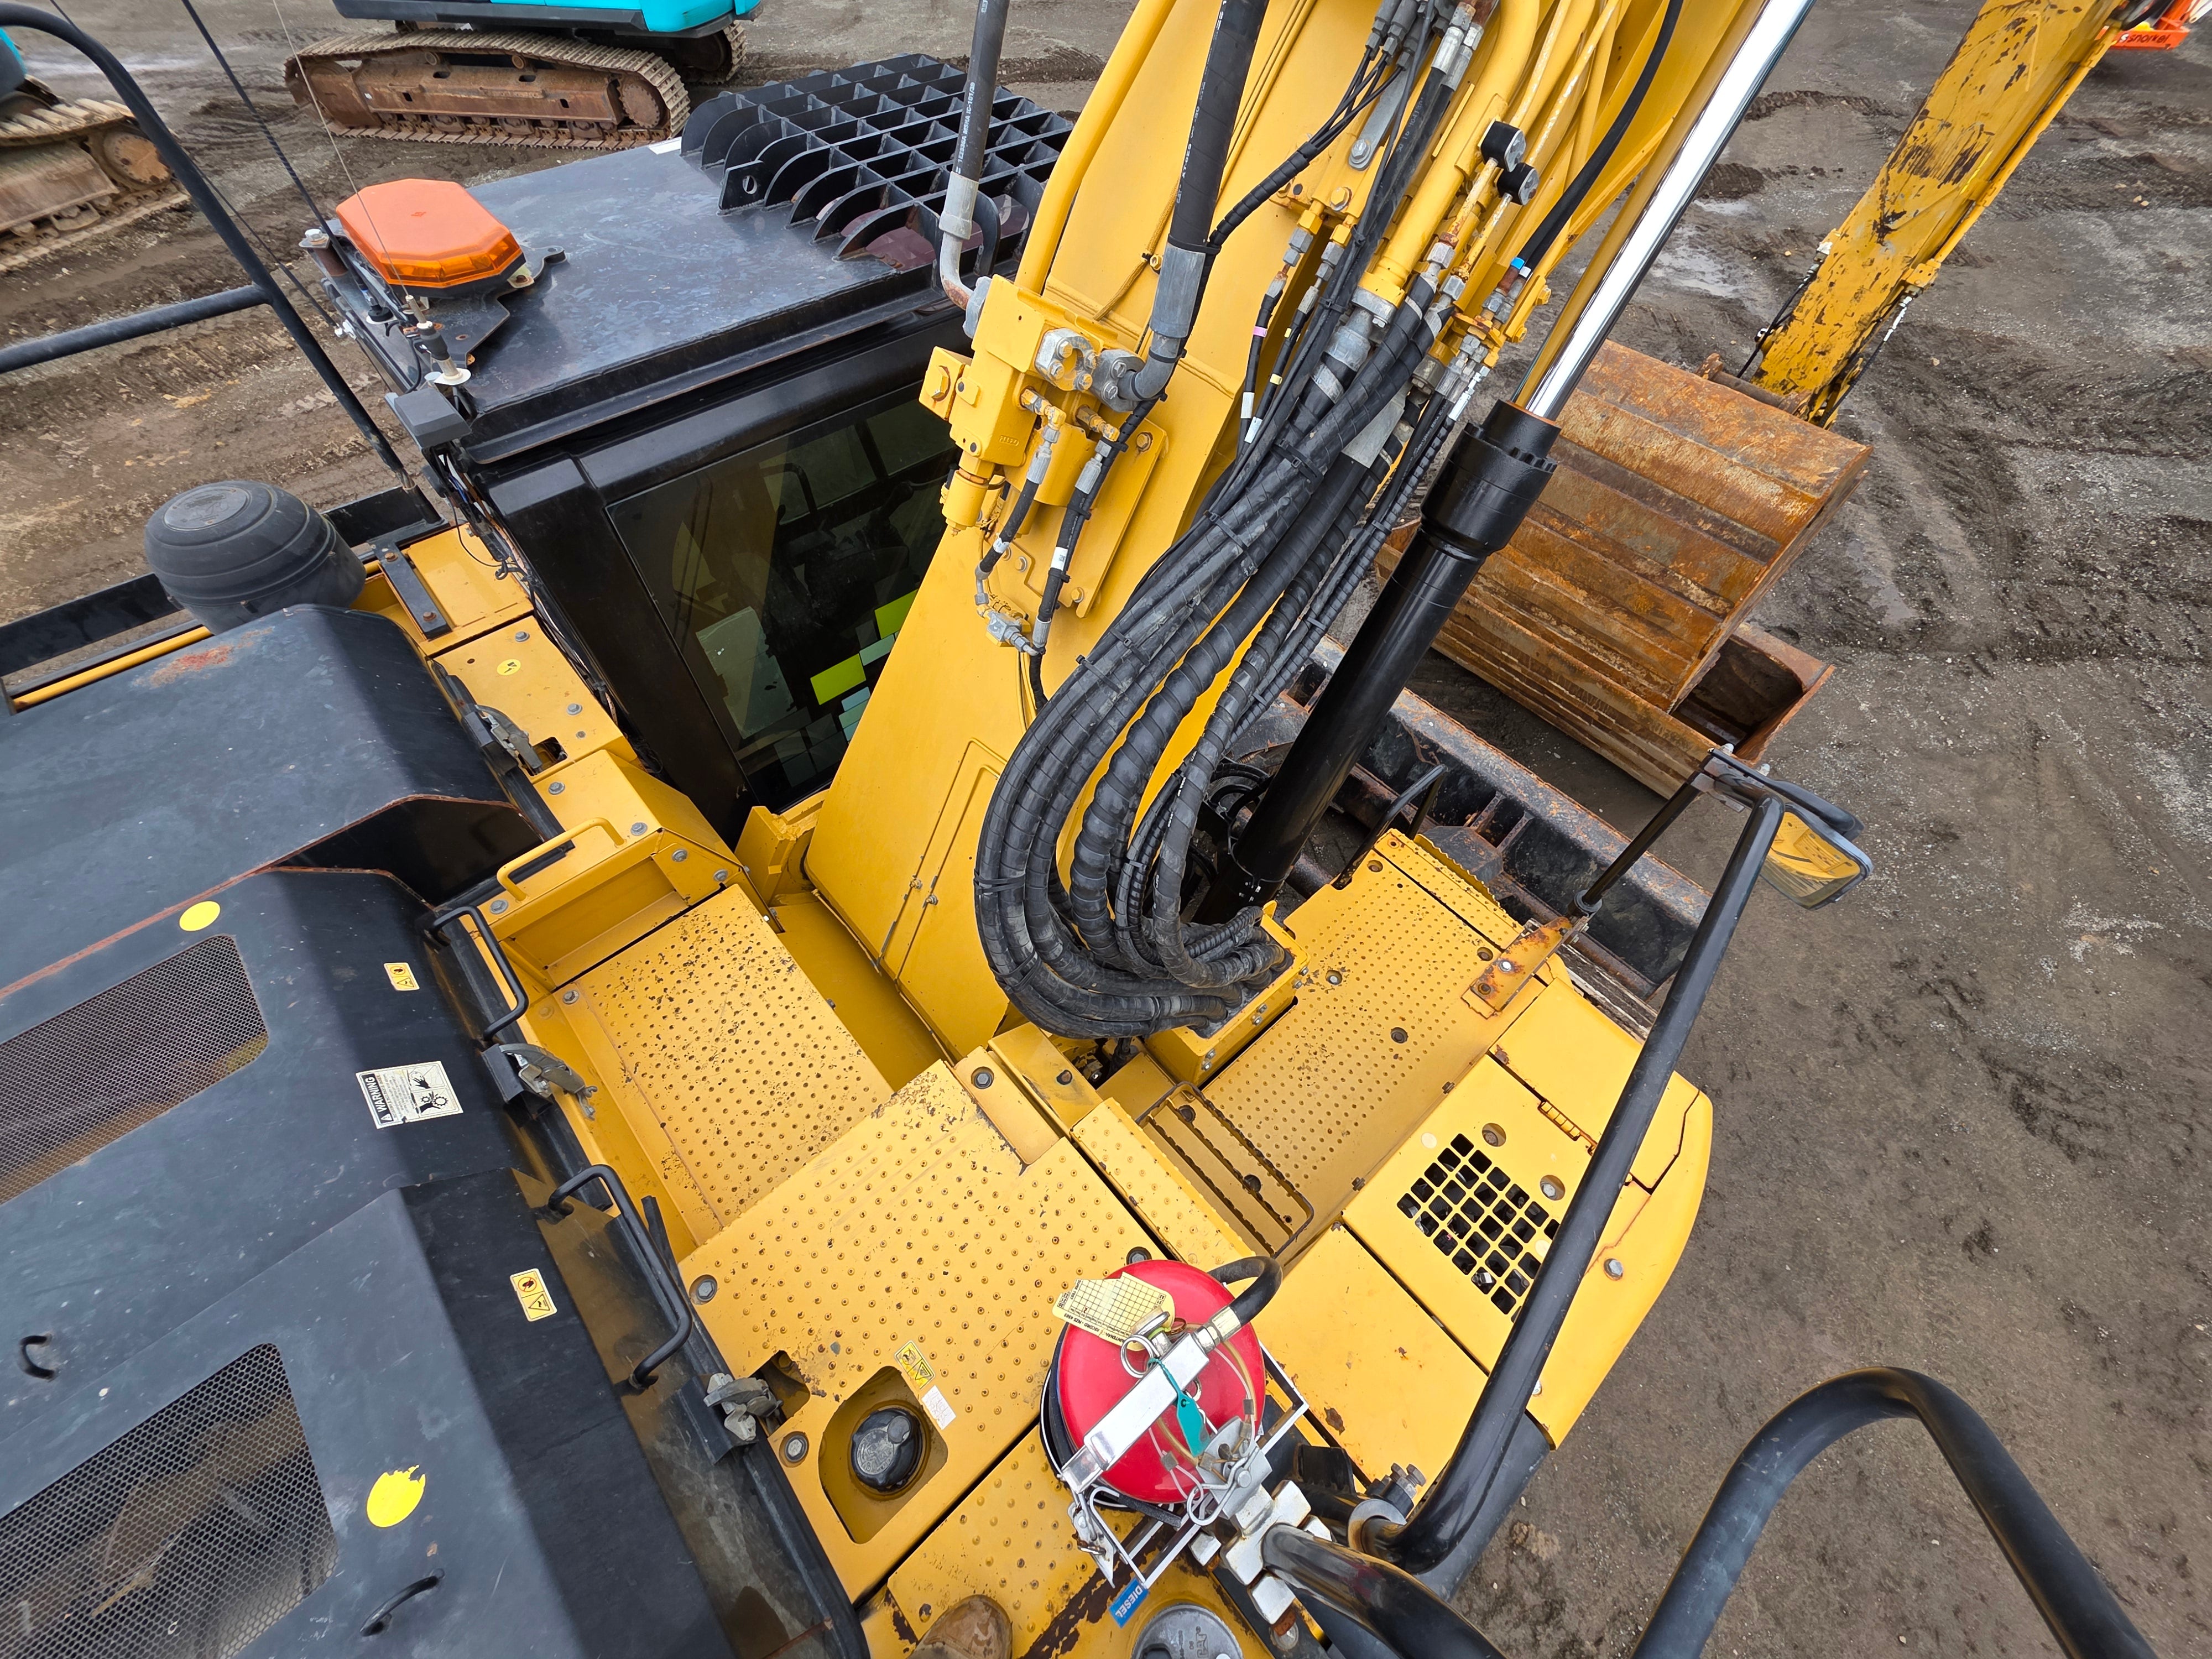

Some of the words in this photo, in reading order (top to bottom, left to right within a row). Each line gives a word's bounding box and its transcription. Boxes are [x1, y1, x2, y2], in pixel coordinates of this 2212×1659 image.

[2127, 33, 2172, 44] snorkel
[962, 114, 971, 134] MSHA
[366, 1077, 388, 1112] WARNING
[1083, 1322, 1100, 1332] RECORD
[1114, 1584, 1143, 1618] DIESEL
